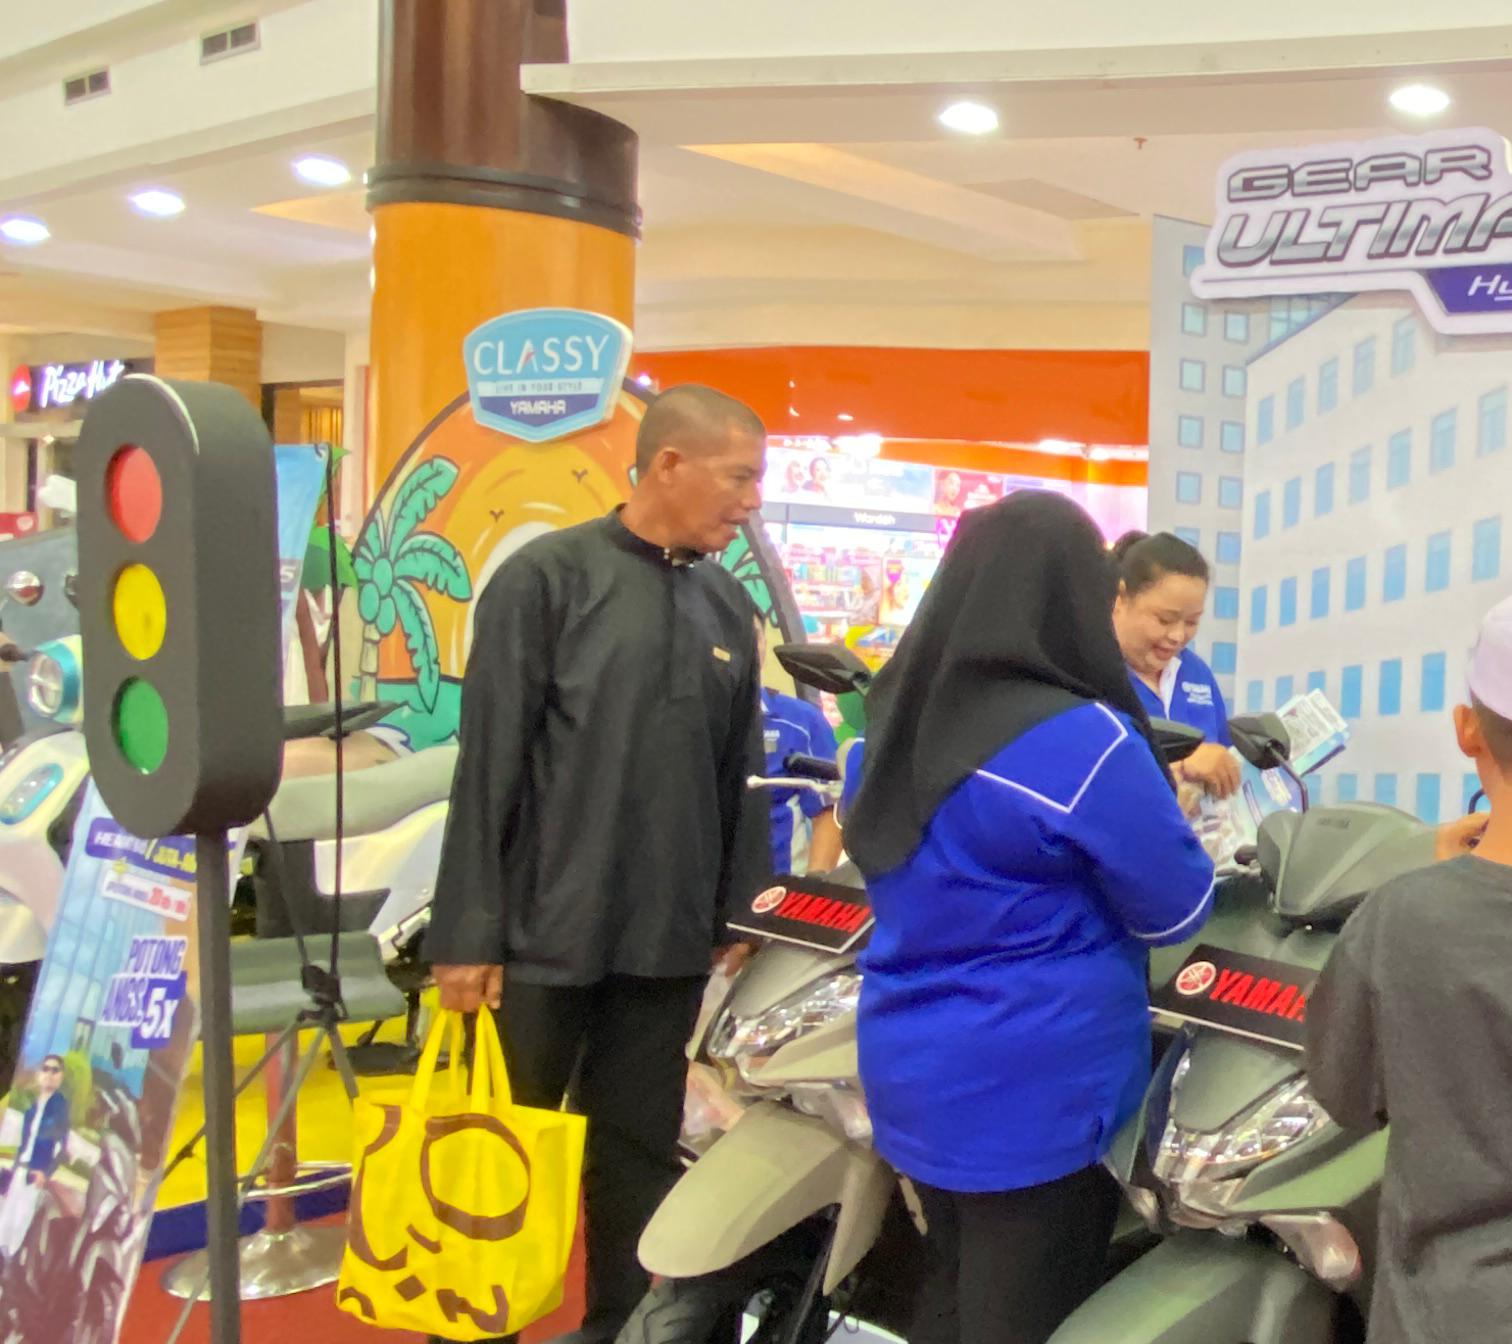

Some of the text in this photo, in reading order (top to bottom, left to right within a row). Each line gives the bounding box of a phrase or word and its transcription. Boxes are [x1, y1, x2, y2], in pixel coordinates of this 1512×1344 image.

[1227, 144, 1493, 202] GEAR
[473, 333, 610, 376] CLASSY
[510, 399, 566, 416] YAMAHA
[773, 891, 872, 933] YAMAHA
[128, 938, 187, 974] POTONG
